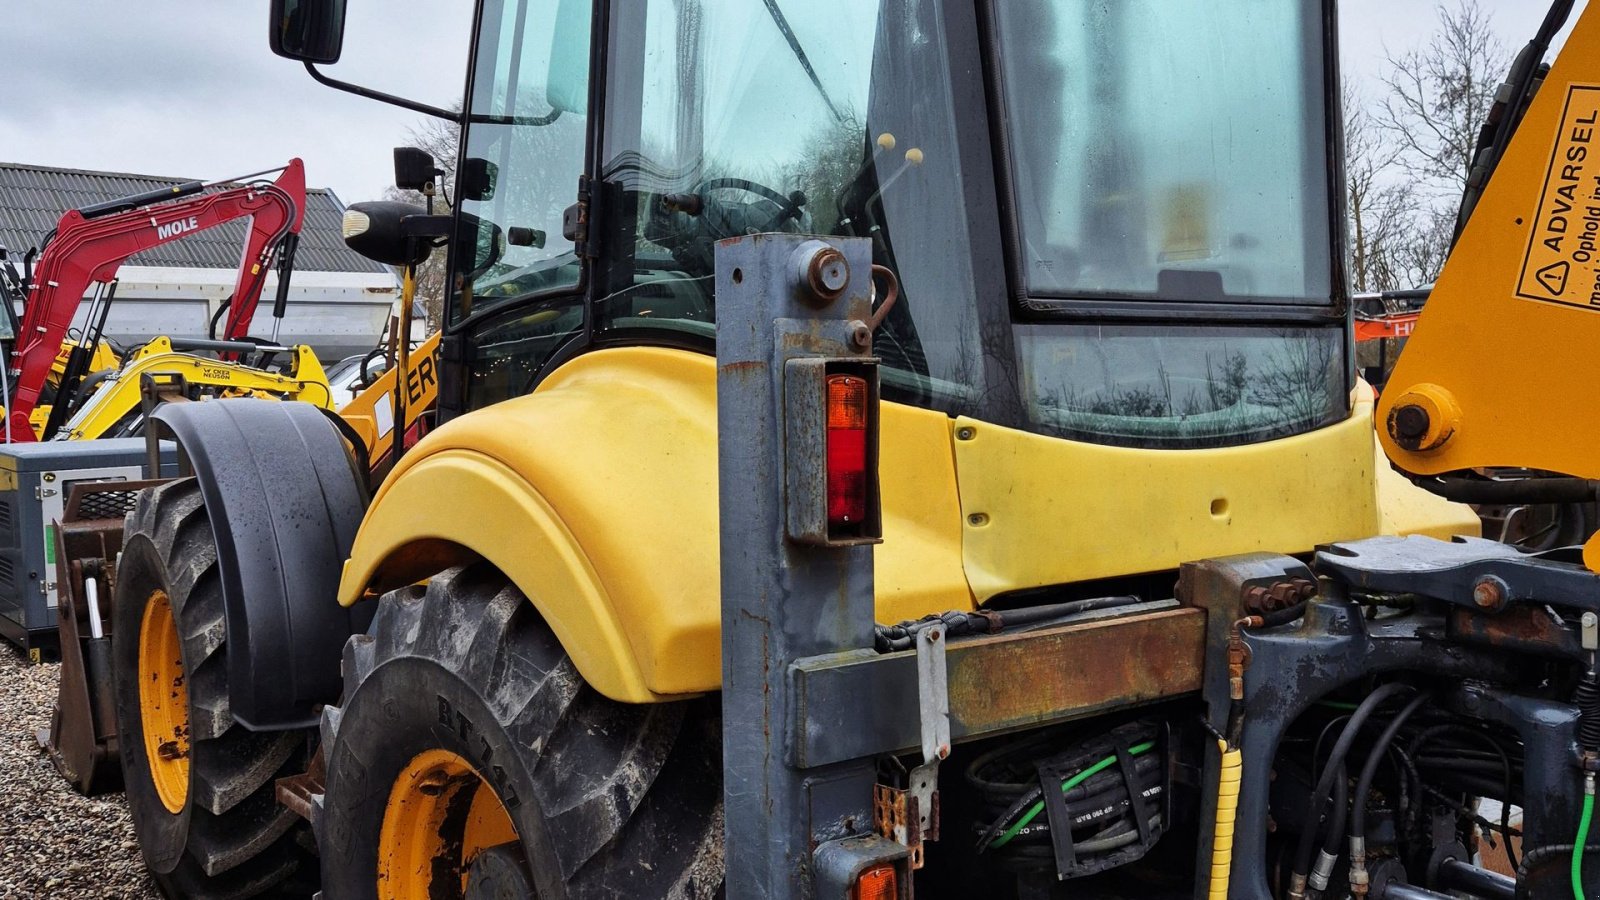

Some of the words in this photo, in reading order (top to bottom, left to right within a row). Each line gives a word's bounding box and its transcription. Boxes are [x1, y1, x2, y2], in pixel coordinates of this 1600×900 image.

[1543, 109, 1598, 253] ADVARSEL
[157, 216, 199, 240] MOLE
[1572, 206, 1600, 264] Ophold
[203, 367, 230, 376] WCKER
[1076, 813, 1092, 823] BAR
